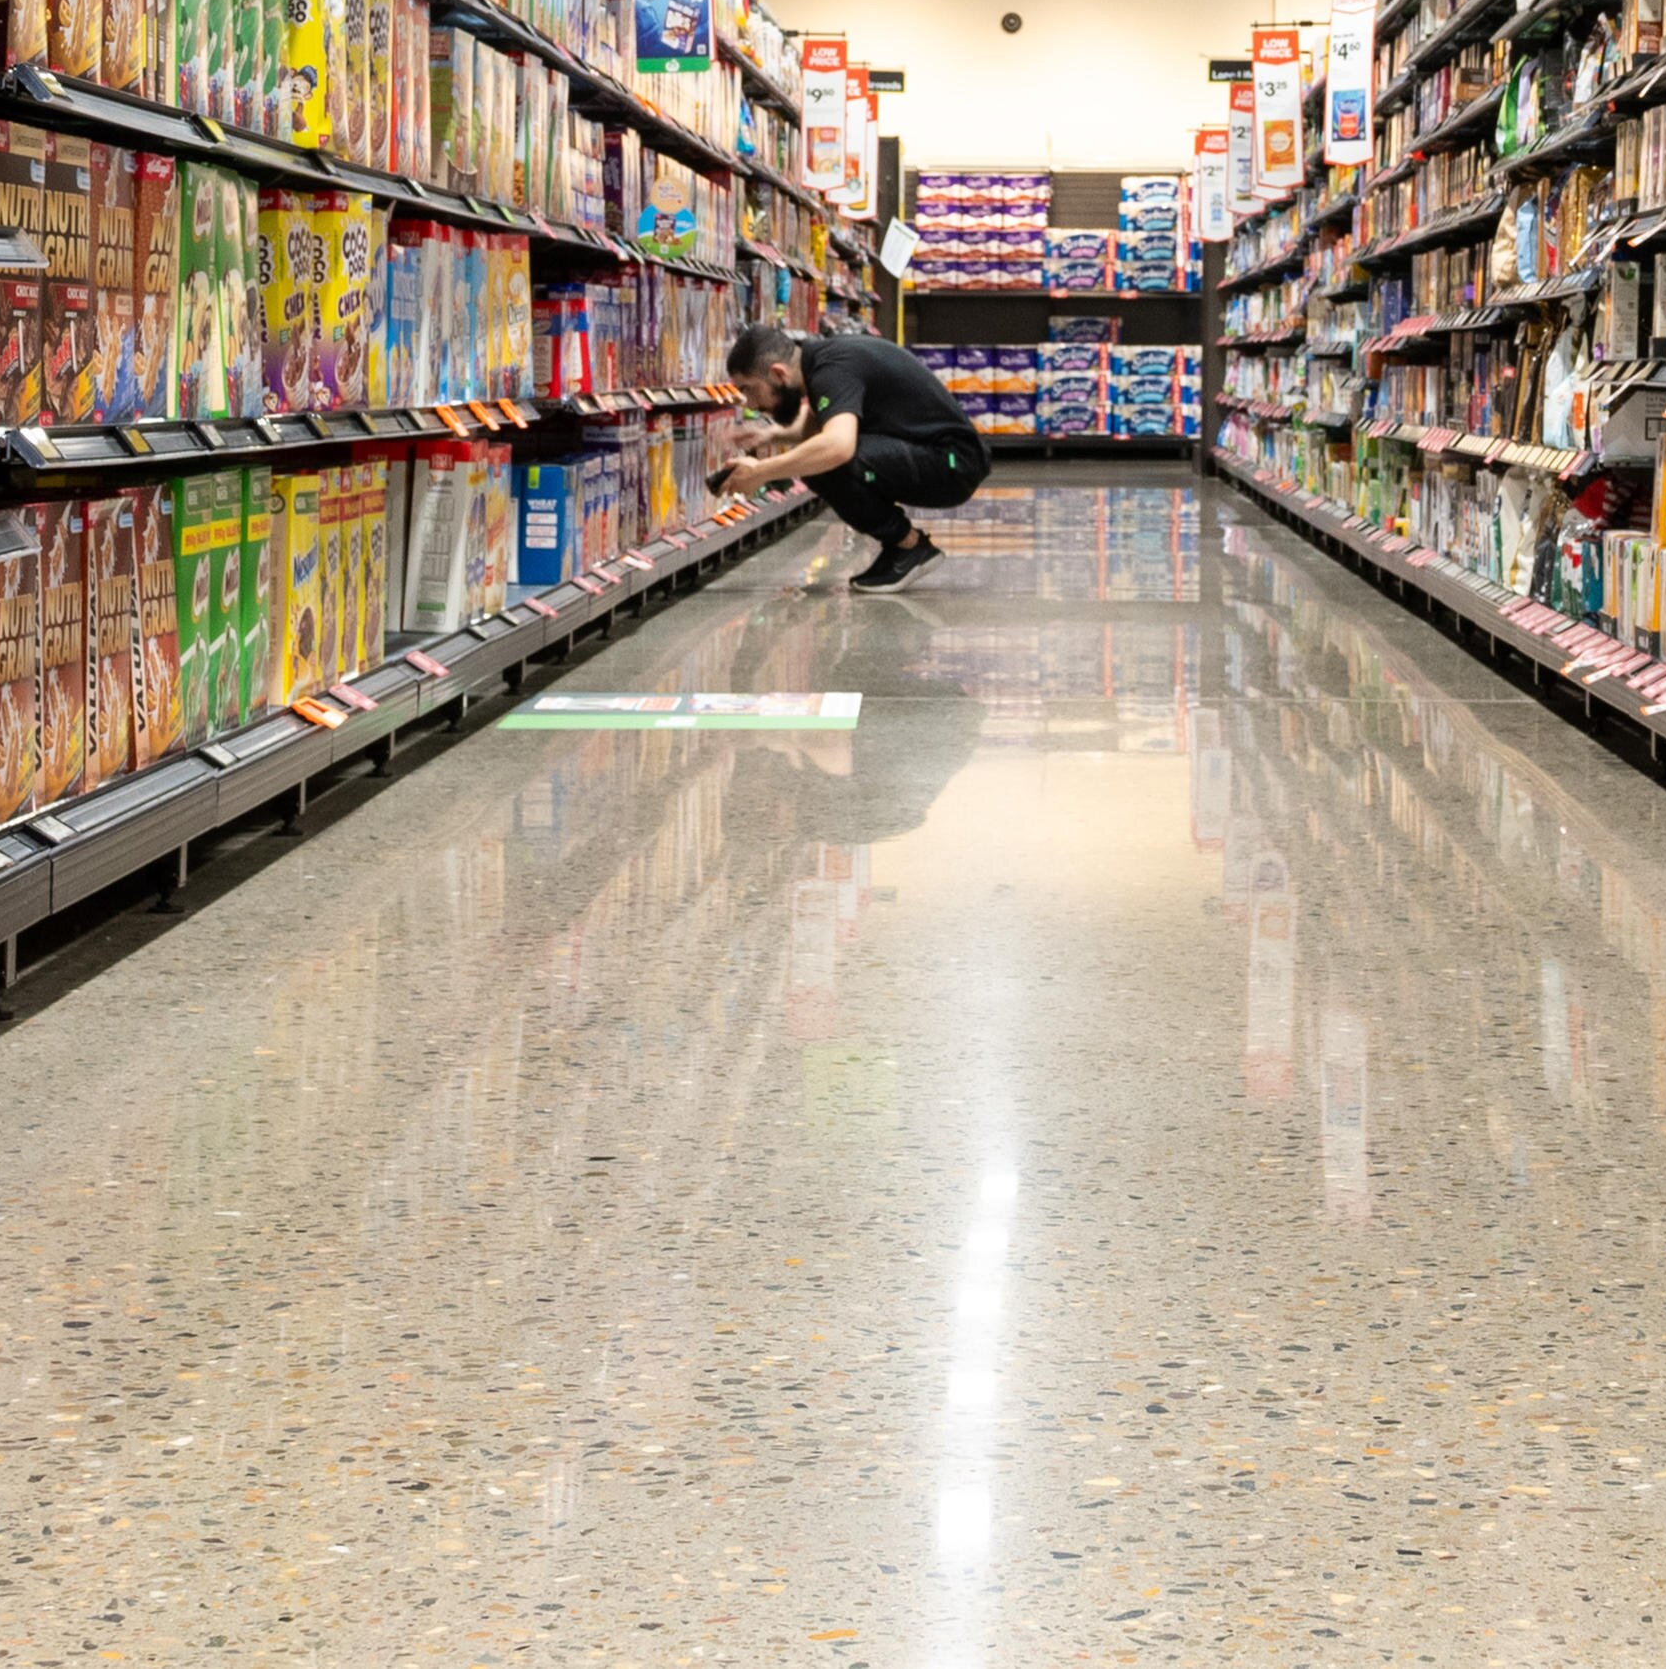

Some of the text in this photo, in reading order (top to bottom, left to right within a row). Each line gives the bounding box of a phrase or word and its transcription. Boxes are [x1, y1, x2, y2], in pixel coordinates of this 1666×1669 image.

[1262, 37, 1290, 49] LOW
[810, 48, 840, 61] LOW
[1260, 47, 1293, 59] PRICE
[808, 57, 841, 68] PRICE
[342, 225, 368, 261] COCO
[338, 290, 361, 318] CHEX
